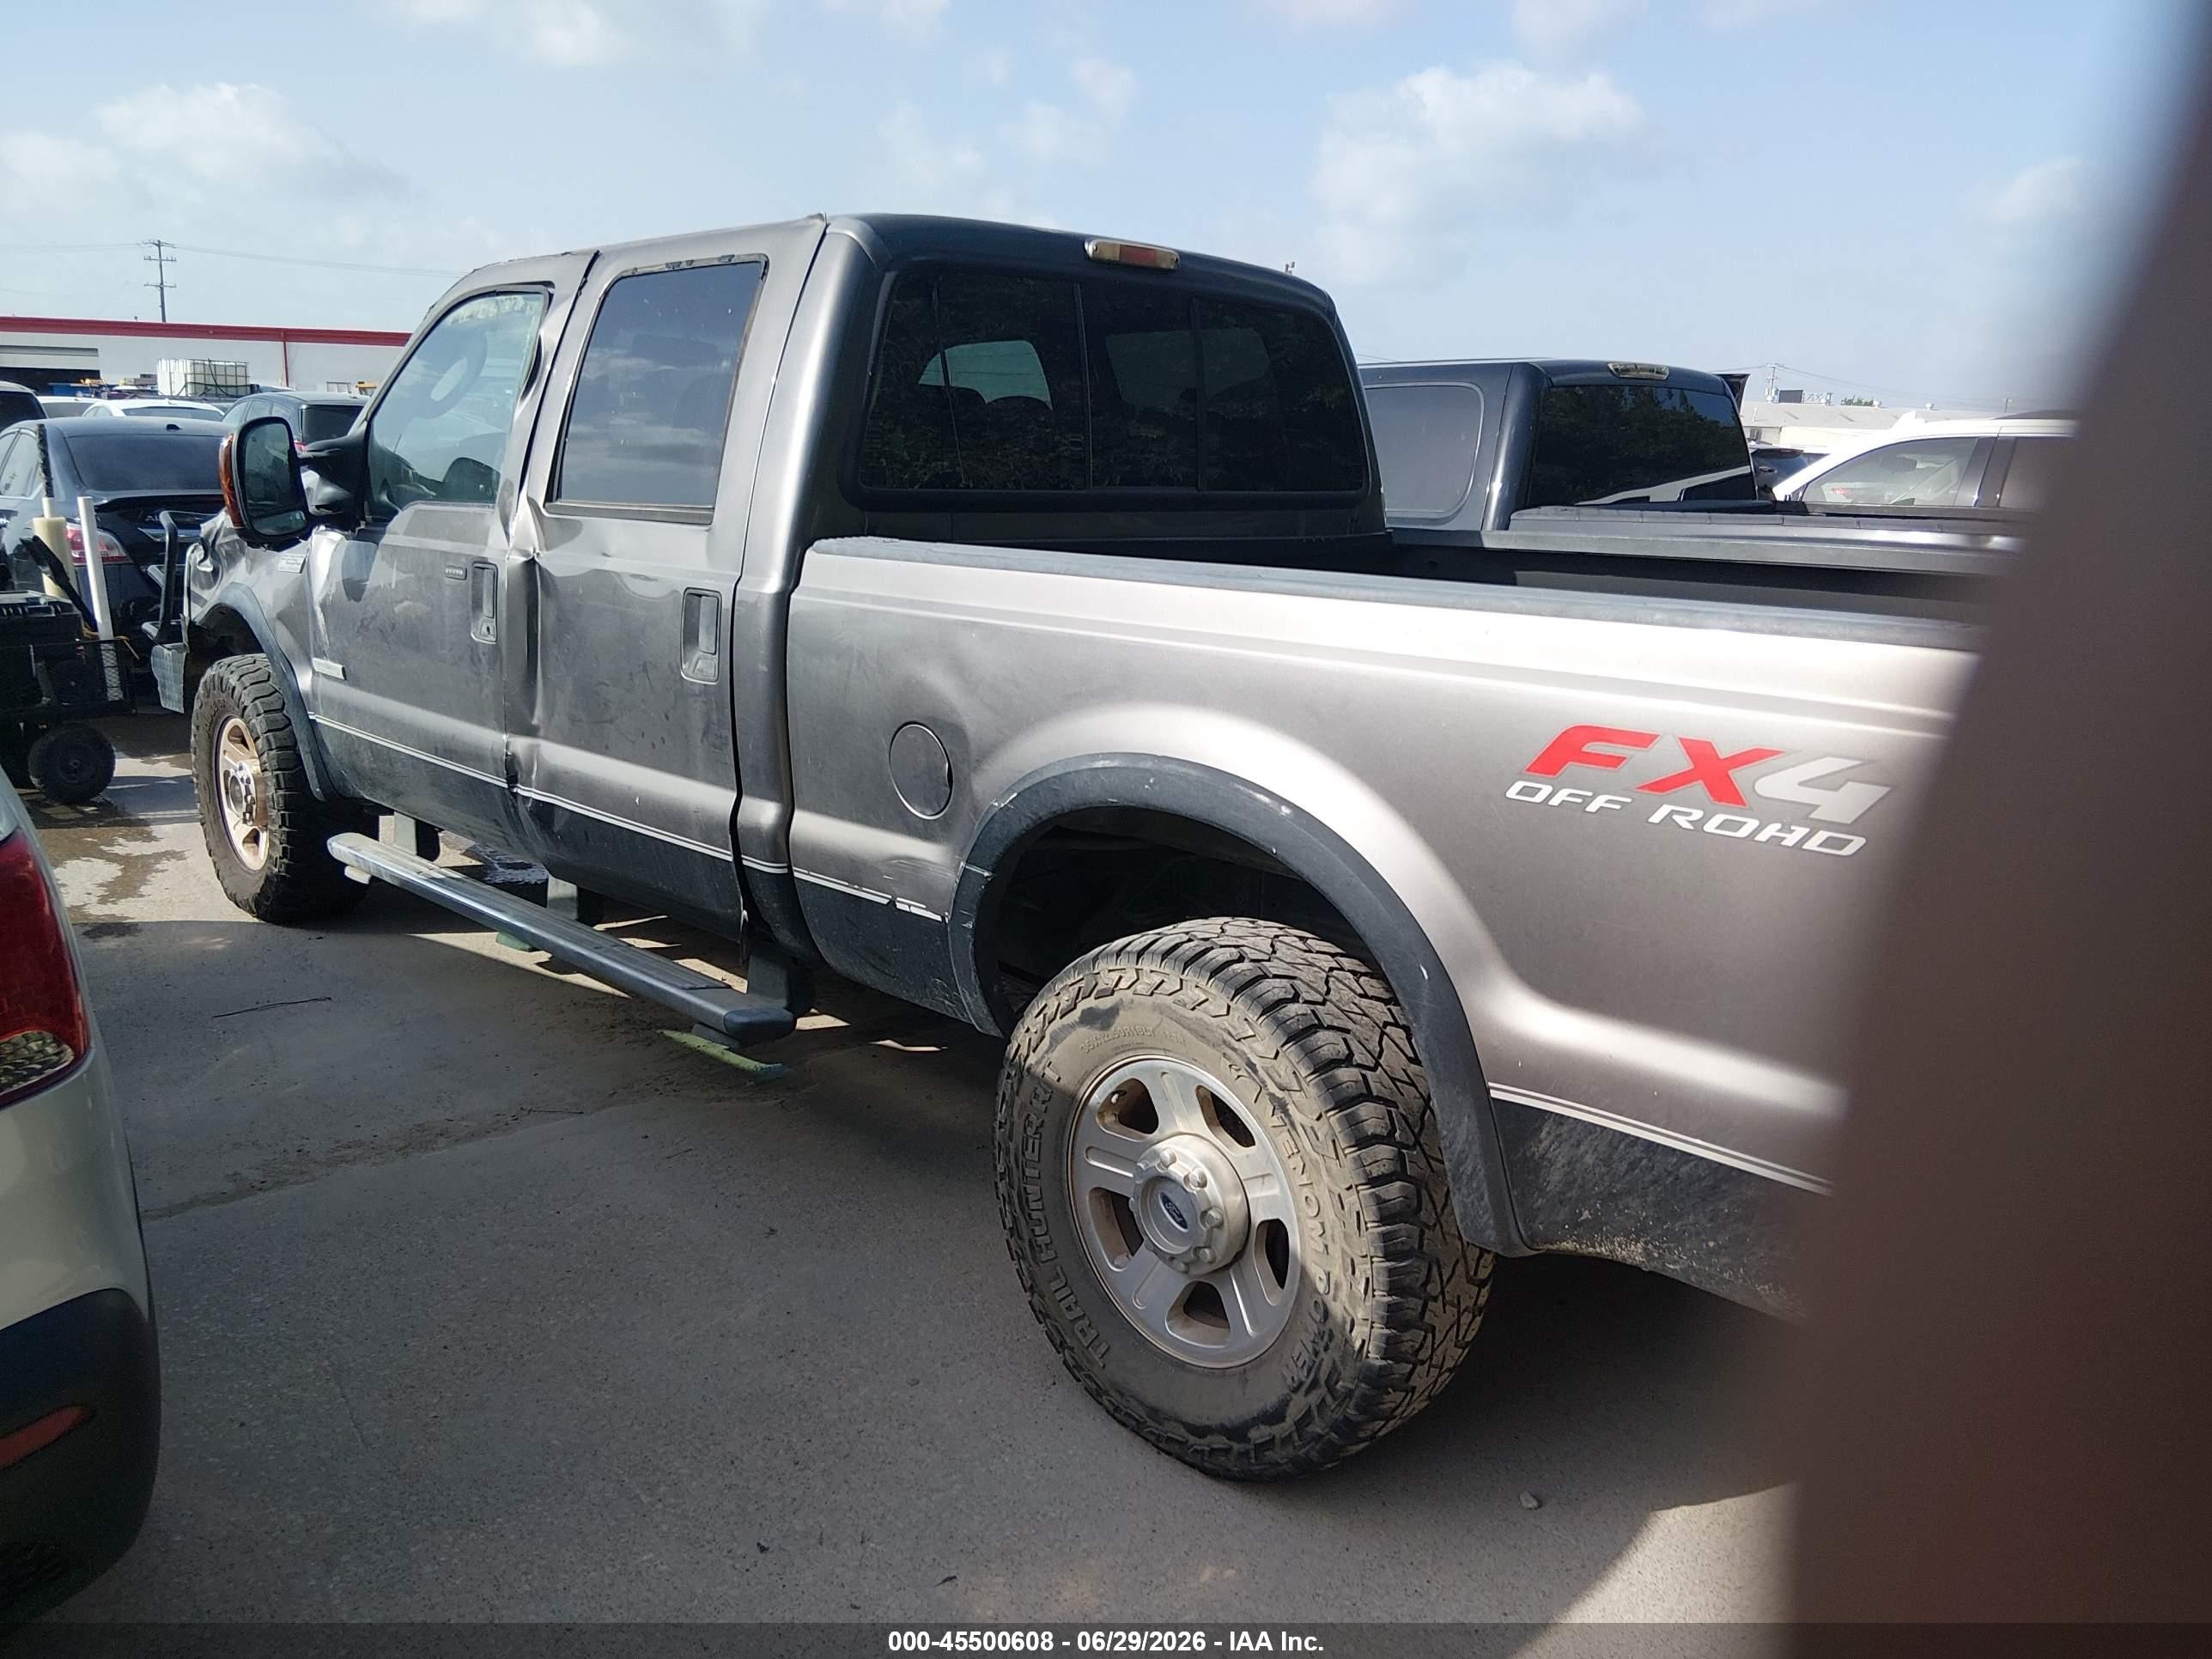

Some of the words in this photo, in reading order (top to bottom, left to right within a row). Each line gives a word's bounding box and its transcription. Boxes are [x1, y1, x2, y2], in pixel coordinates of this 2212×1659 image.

[1504, 780, 1632, 814] OFF
[1647, 803, 1867, 857] ROAD
[1523, 723, 1891, 824] FX4
[1022, 1113, 1058, 1264] HUNTER
[1265, 1103, 1330, 1257] VENOM
[1049, 1264, 1111, 1370] TRAIL
